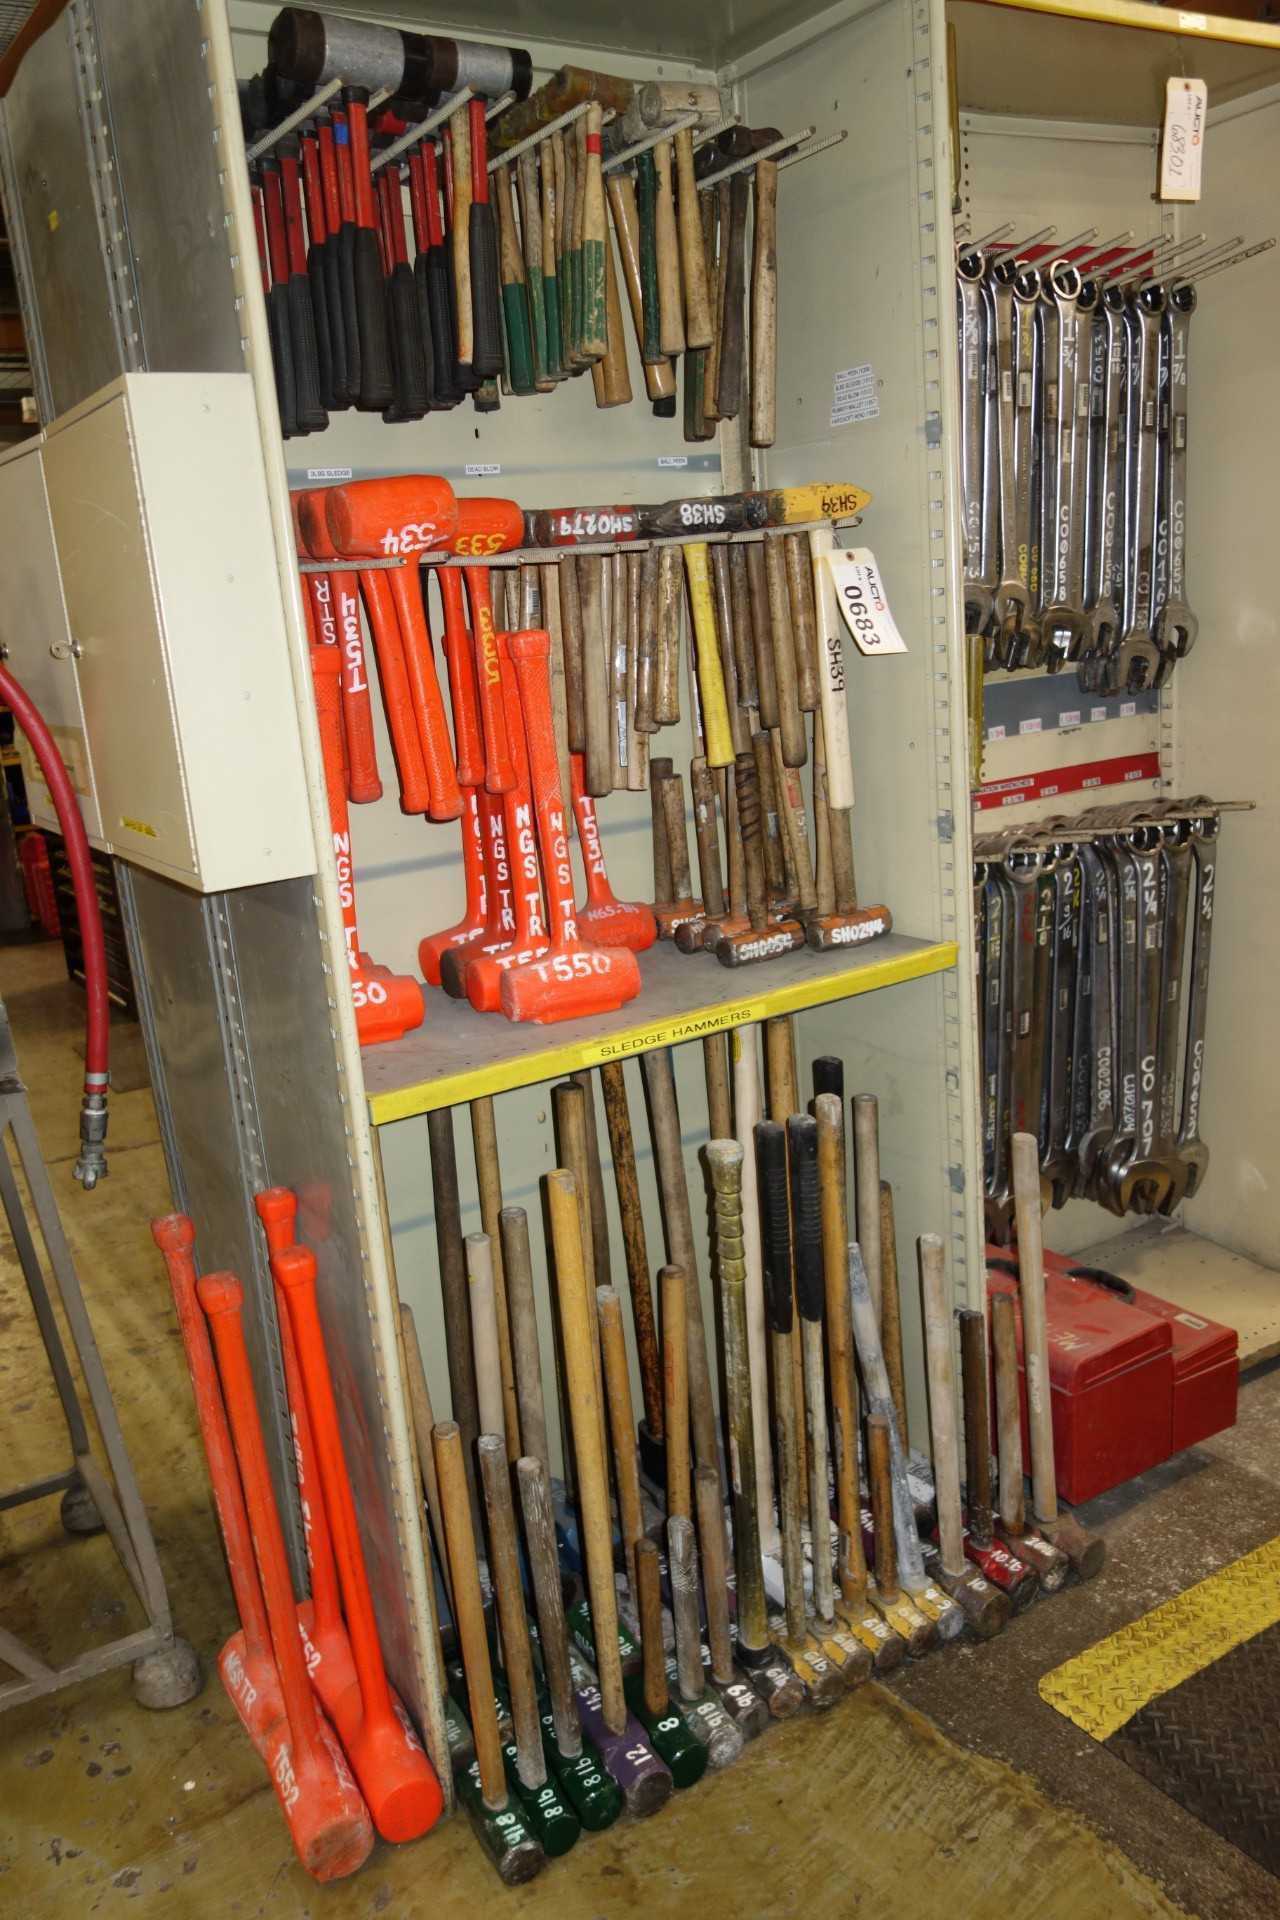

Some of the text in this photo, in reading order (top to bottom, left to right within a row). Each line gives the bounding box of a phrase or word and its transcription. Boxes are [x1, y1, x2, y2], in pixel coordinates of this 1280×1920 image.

[680, 503, 726, 526] SH38
[821, 494, 857, 514] SH39
[380, 523, 436, 554] 534
[455, 533, 506, 556] 533
[864, 565, 886, 612] AUCTO
[844, 585, 882, 646] 0683
[341, 591, 368, 694] T534
[827, 638, 847, 692] SH39
[490, 814, 509, 881] NGS
[579, 796, 607, 880] T534
[515, 803, 544, 937] NGS TR
[550, 811, 578, 941] NGS TR
[1142, 861, 1157, 887] 2
[530, 951, 612, 983] T550
[600, 1009, 752, 1057] SLEDGE HAMMERS
[658, 1717, 680, 1732] 8
[625, 1743, 653, 1767] 12
